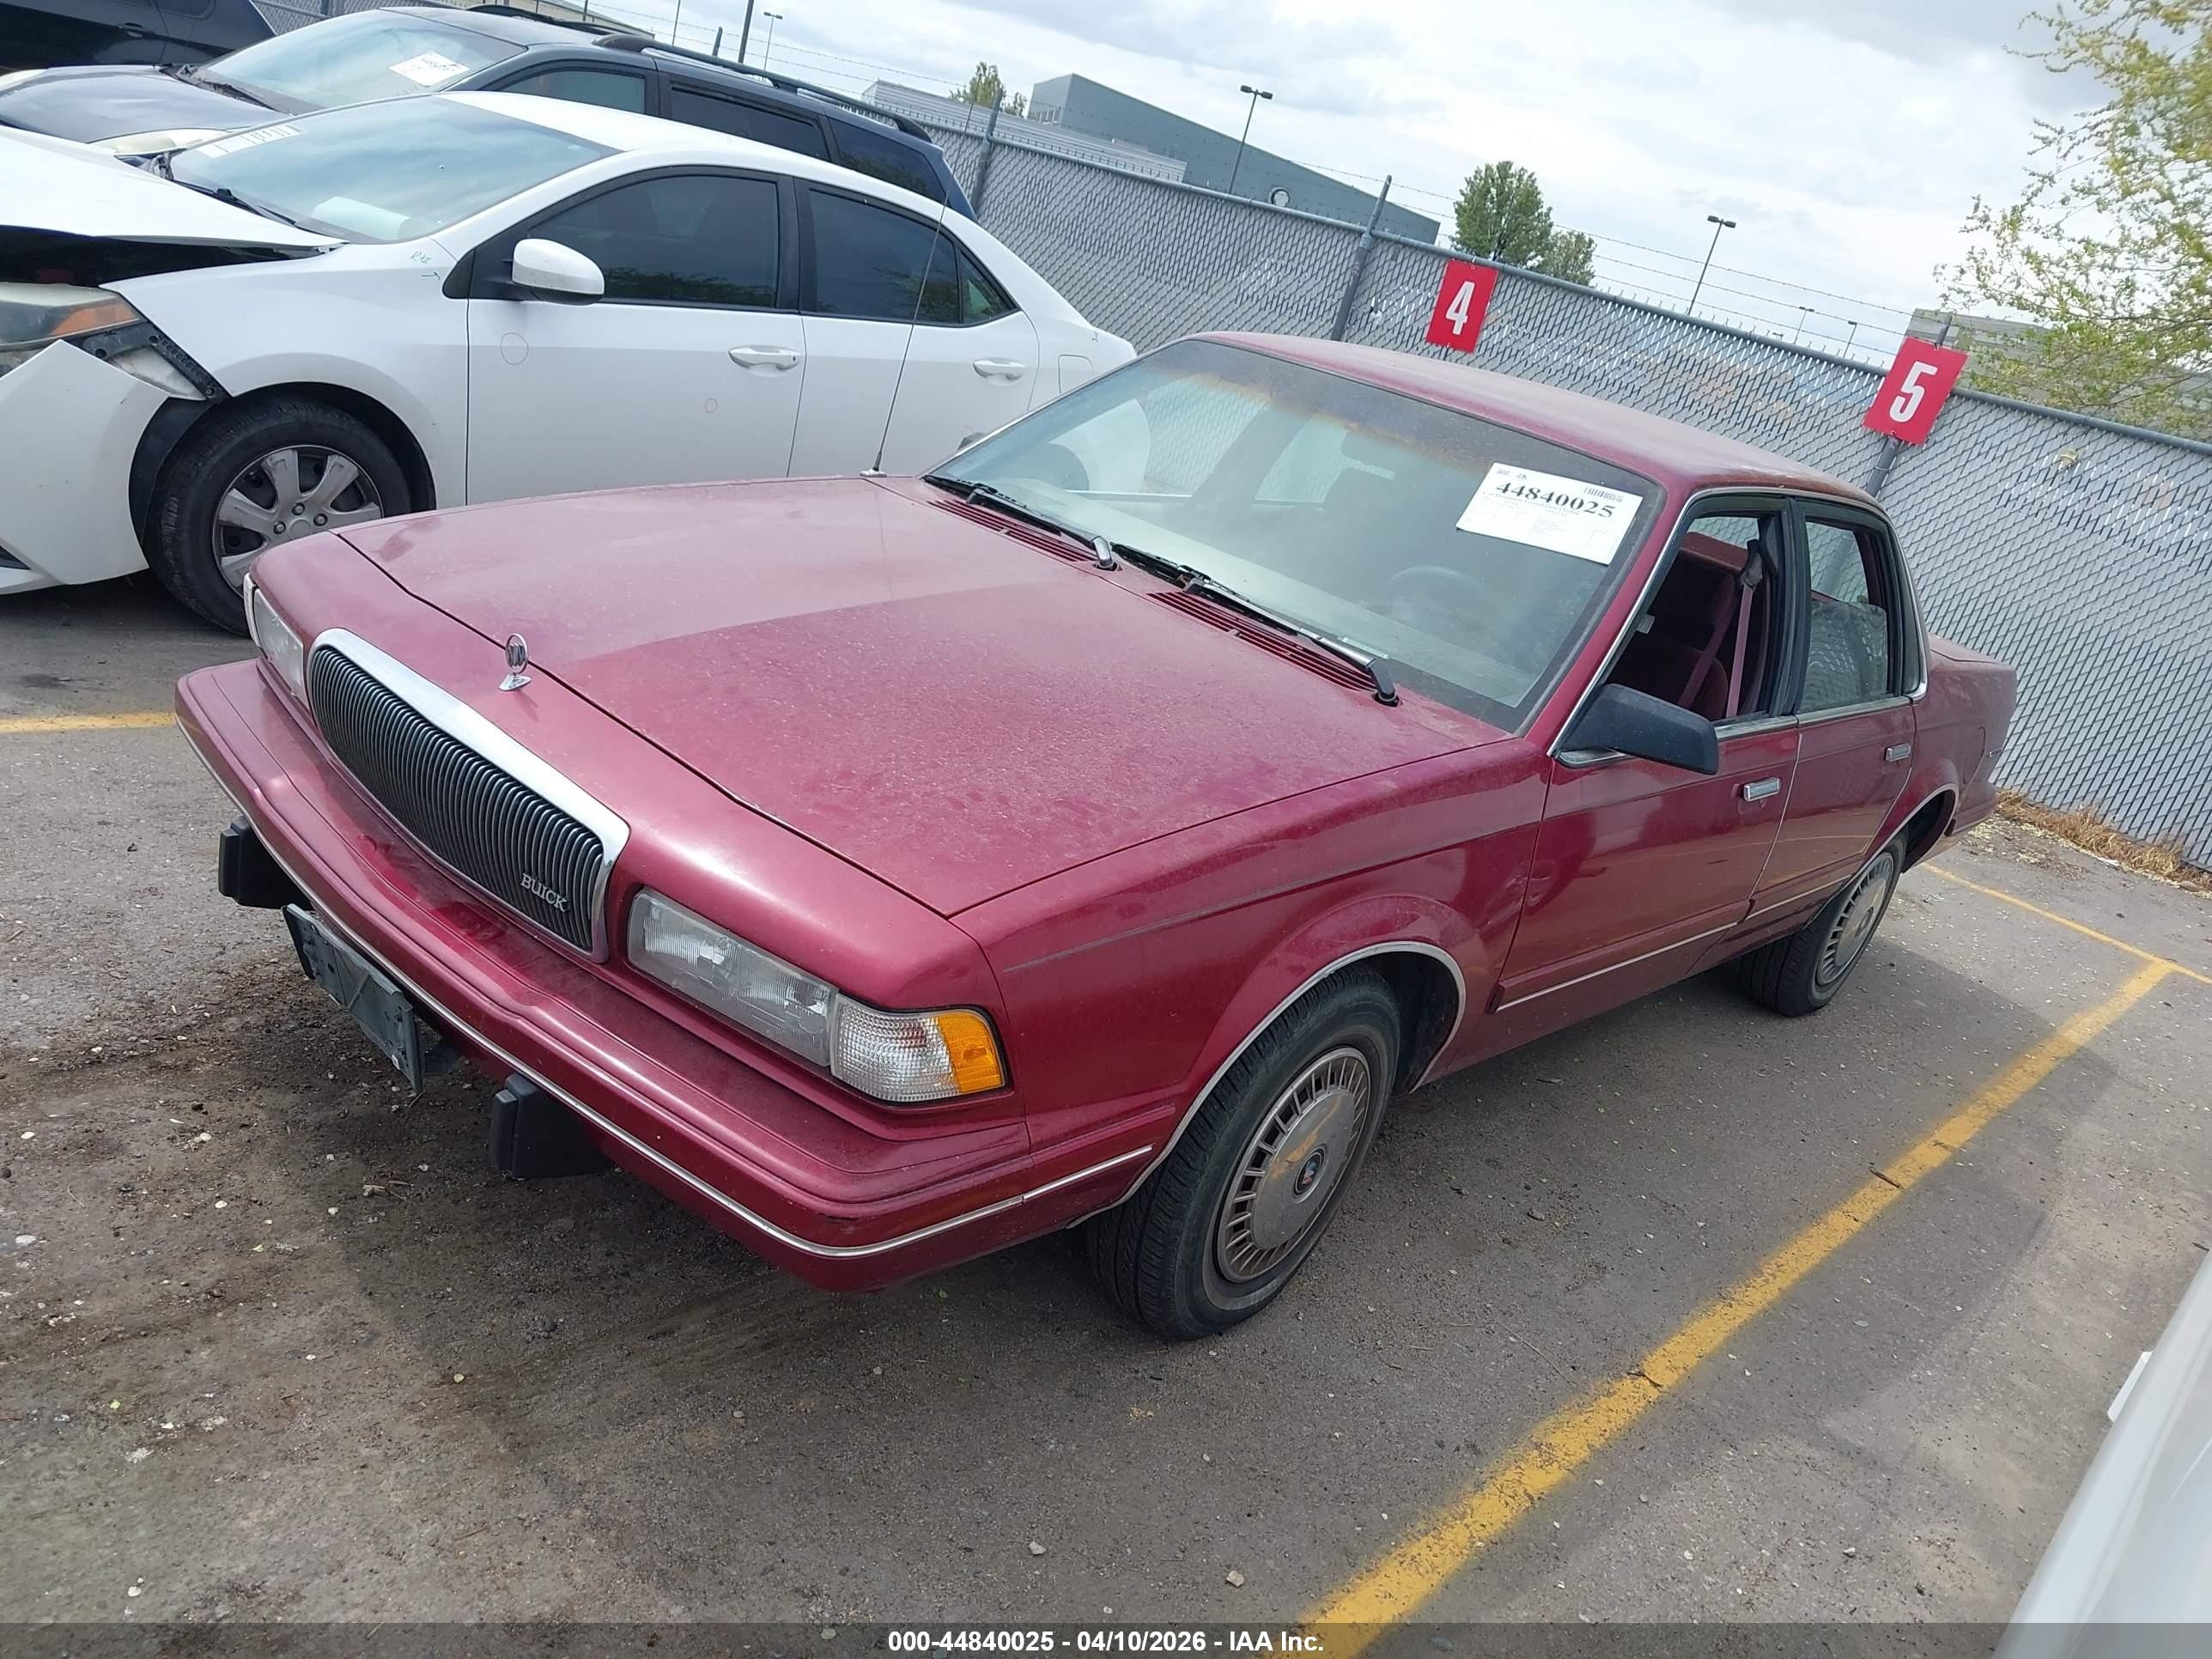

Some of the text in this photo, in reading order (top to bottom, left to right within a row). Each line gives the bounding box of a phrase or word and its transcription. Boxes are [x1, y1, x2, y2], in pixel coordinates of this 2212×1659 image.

[1445, 281, 1475, 336] 4
[1889, 361, 1938, 422] 5
[1496, 482, 1616, 518] 44840025
[520, 872, 567, 913] BUICK
